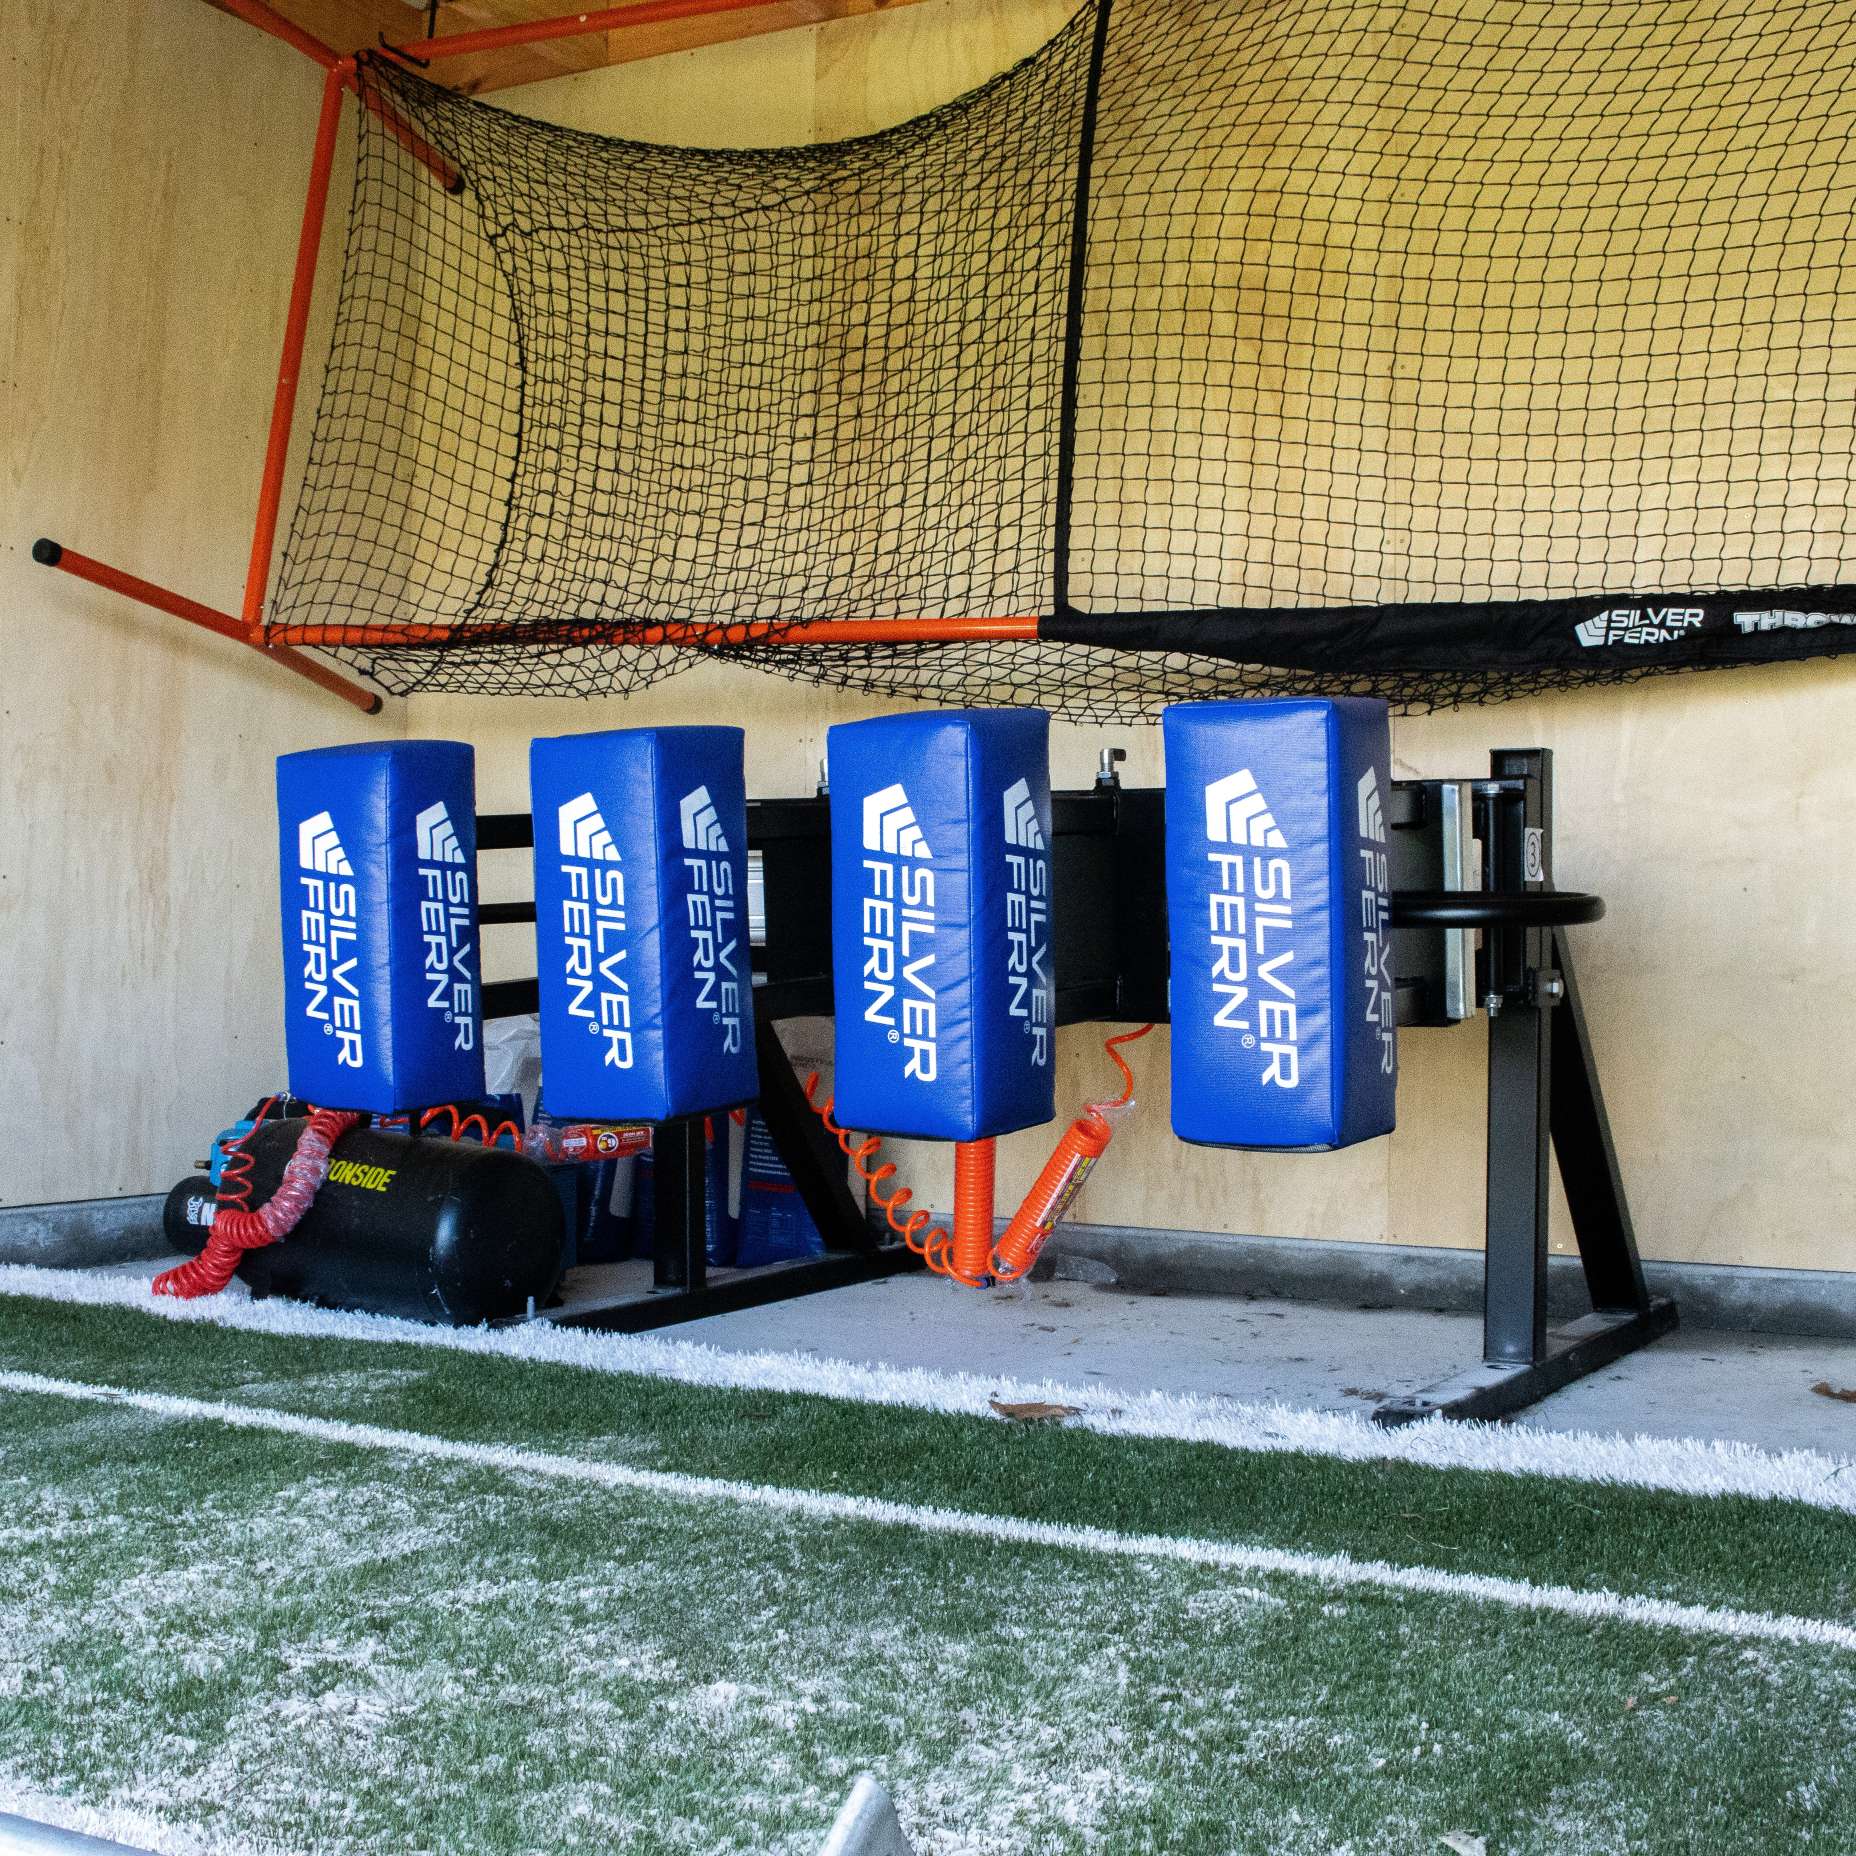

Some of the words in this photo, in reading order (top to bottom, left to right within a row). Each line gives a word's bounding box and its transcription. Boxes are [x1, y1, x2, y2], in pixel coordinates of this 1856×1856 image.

[1610, 607, 1705, 628] SILVER
[329, 881, 363, 1068] SILVER
[447, 870, 474, 1051] SILVER
[595, 868, 634, 1069] SILVER
[711, 860, 740, 1055] SILVER
[901, 865, 937, 1082] SILVER
[1029, 858, 1049, 1067] SILVER
[1253, 857, 1299, 1088] SILVER
[1376, 852, 1393, 1074] SILVER
[328, 1158, 397, 1192] ONSIDE
